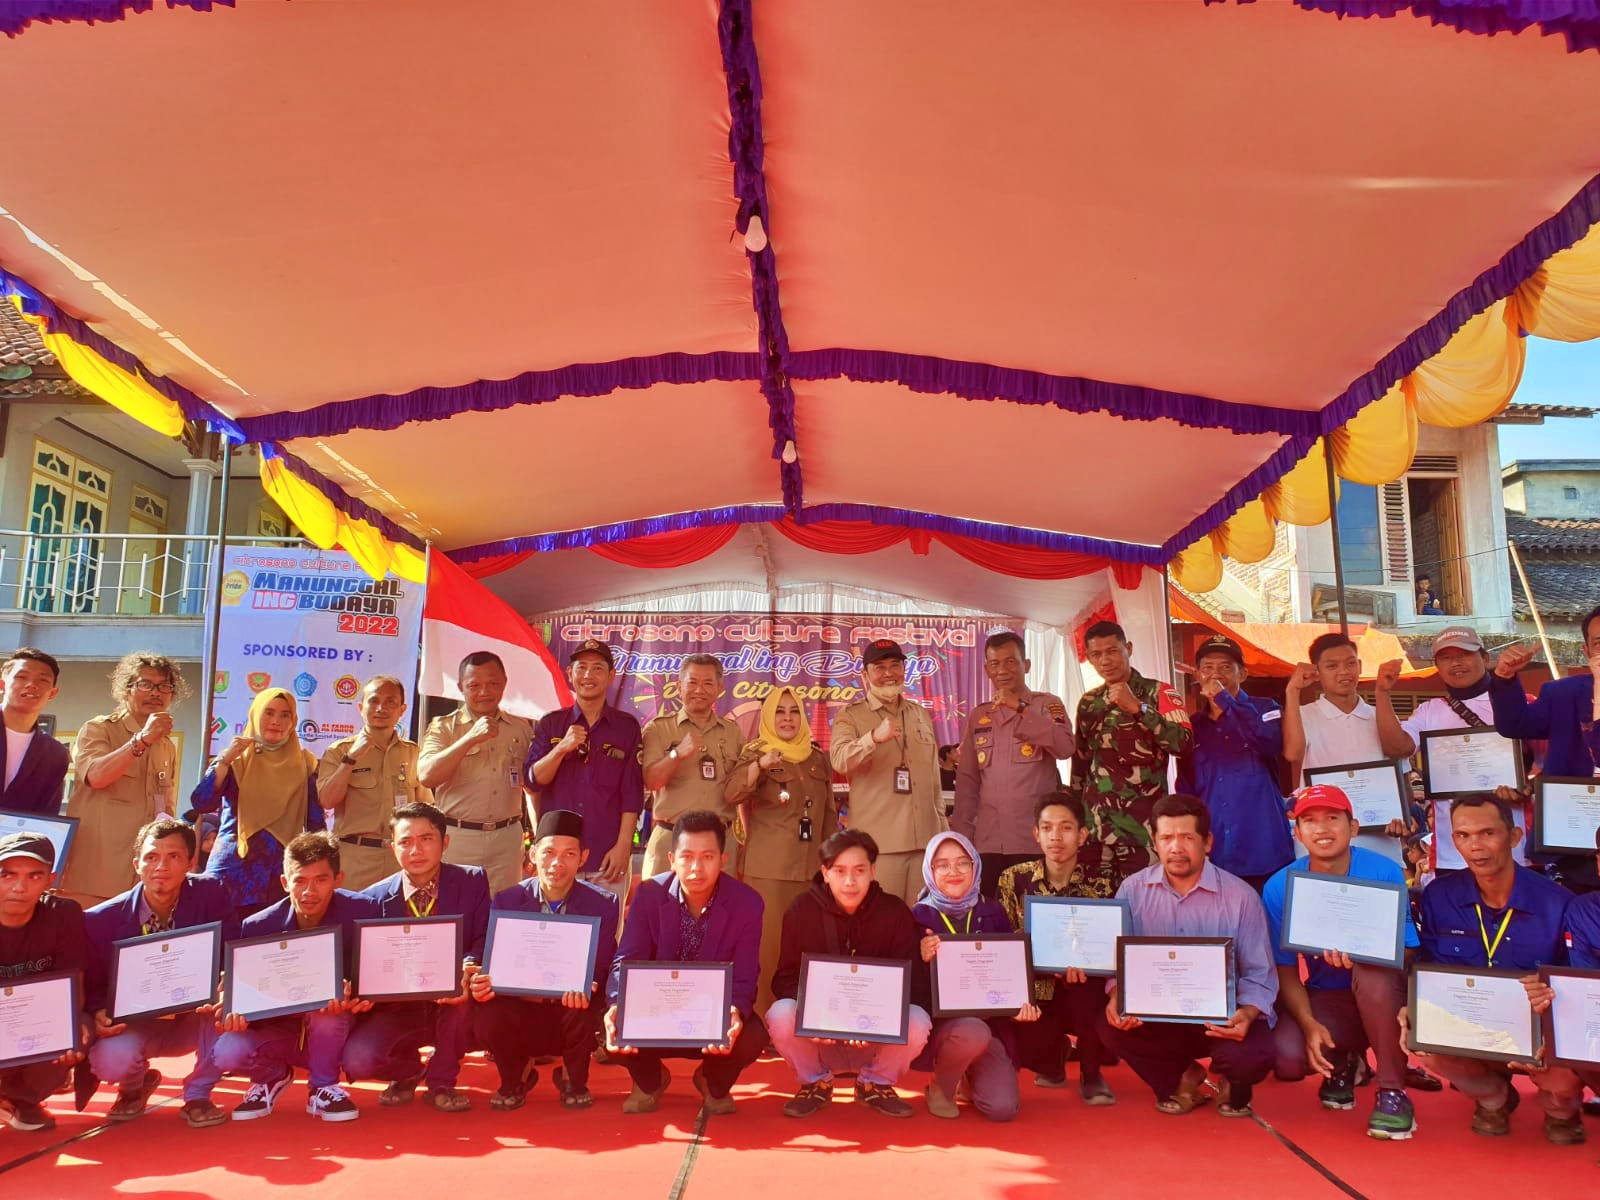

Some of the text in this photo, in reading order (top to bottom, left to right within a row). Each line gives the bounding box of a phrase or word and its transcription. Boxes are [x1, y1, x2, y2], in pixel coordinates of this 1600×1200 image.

[337, 613, 399, 637] 2022
[560, 618, 976, 648] citrosono culture festival
[243, 644, 339, 660] SPONSORED
[343, 648, 364, 661] BY
[755, 648, 799, 682] ing
[801, 649, 938, 686] Buya
